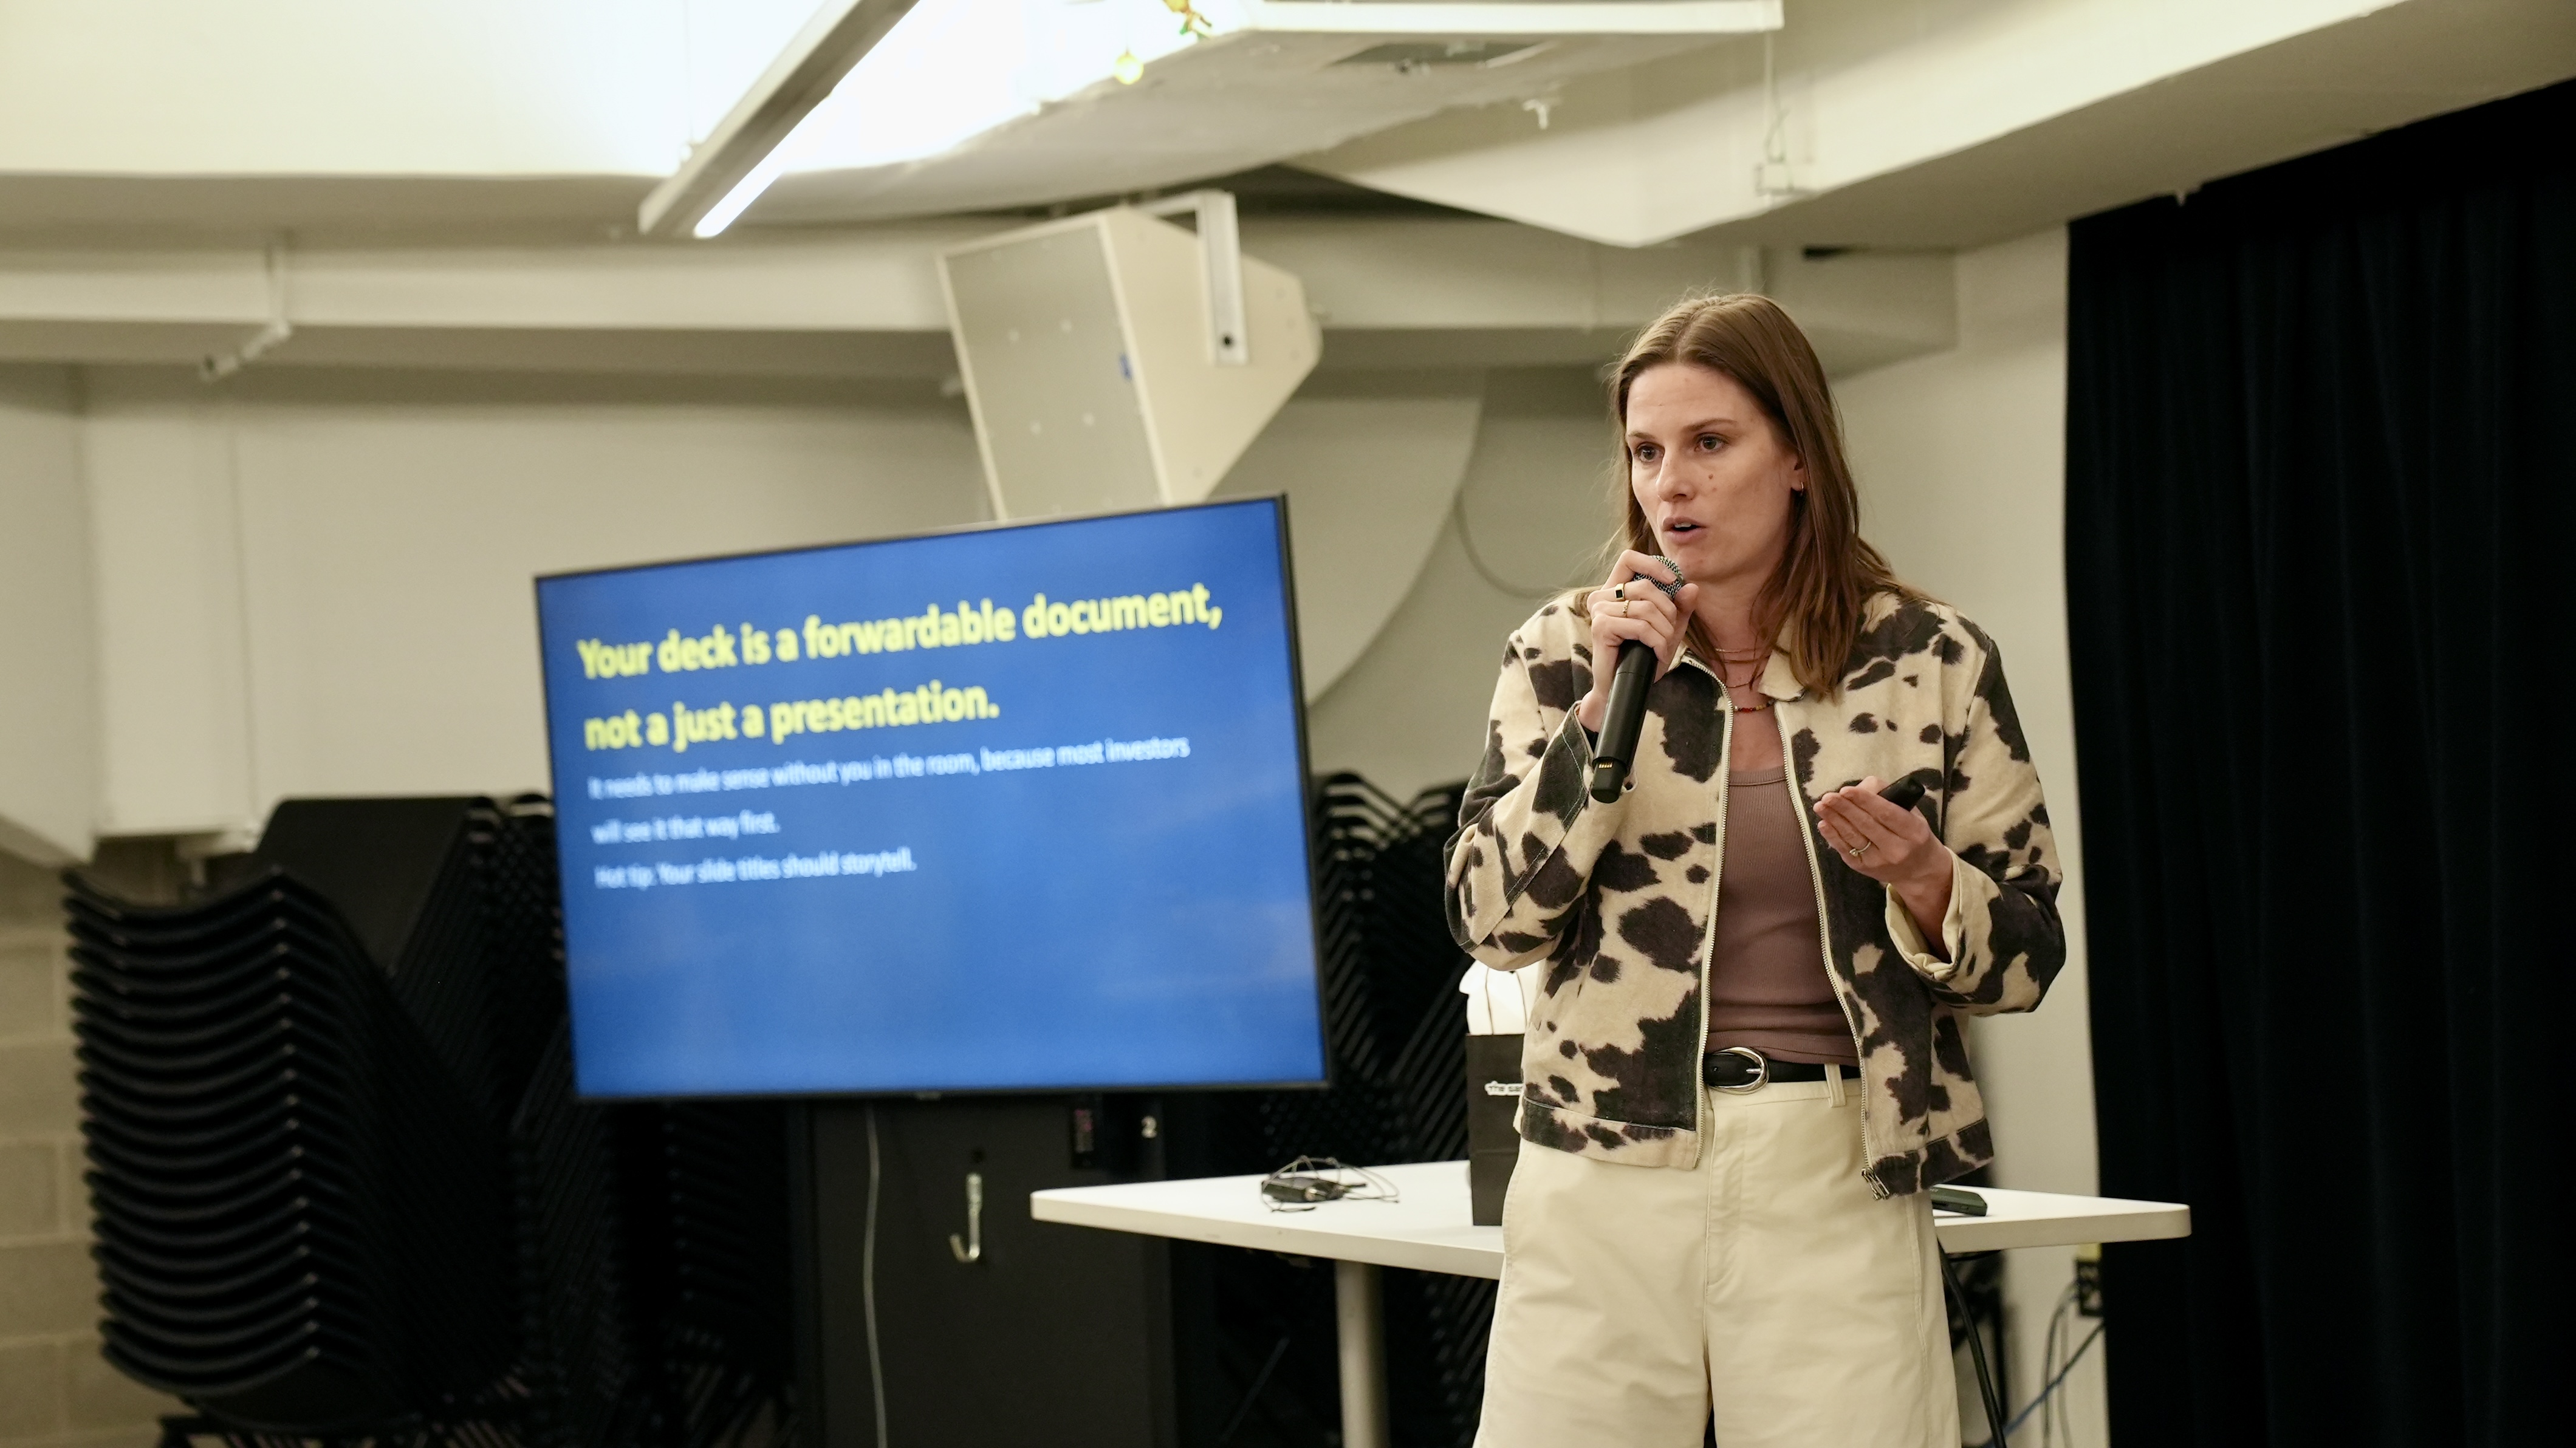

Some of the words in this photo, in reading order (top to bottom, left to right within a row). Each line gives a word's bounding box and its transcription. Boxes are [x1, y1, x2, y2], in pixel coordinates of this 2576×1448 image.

[577, 638, 654, 679] Your
[657, 624, 738, 673] deck
[741, 622, 772, 665] is
[775, 628, 799, 662] a
[803, 598, 1016, 660] forwardable
[1022, 582, 1222, 639] document,
[585, 709, 643, 750] not
[646, 712, 669, 746] a
[673, 701, 738, 753] just
[741, 705, 765, 739] a
[769, 679, 1000, 745] presentation.
[587, 777, 603, 799] It
[605, 772, 653, 798] needs
[653, 774, 673, 795] to
[674, 767, 720, 793] make
[721, 768, 770, 790] sense
[771, 760, 838, 786] without
[839, 761, 872, 786] you
[873, 755, 893, 779] in
[893, 753, 925, 778] the
[925, 753, 980, 776] room,
[980, 746, 1056, 771] because
[1057, 740, 1105, 767] most
[1105, 737, 1191, 762] investors
[591, 819, 622, 844] will
[622, 822, 651, 842] see
[652, 817, 668, 841] it
[668, 814, 704, 839] that
[704, 816, 739, 840] way
[739, 810, 781, 835] first.
[595, 866, 627, 889] Hot
[656, 861, 694, 885] Your
[695, 857, 736, 883] slide
[736, 855, 781, 881] titles
[781, 850, 840, 878] should
[840, 846, 917, 878] storytell.
